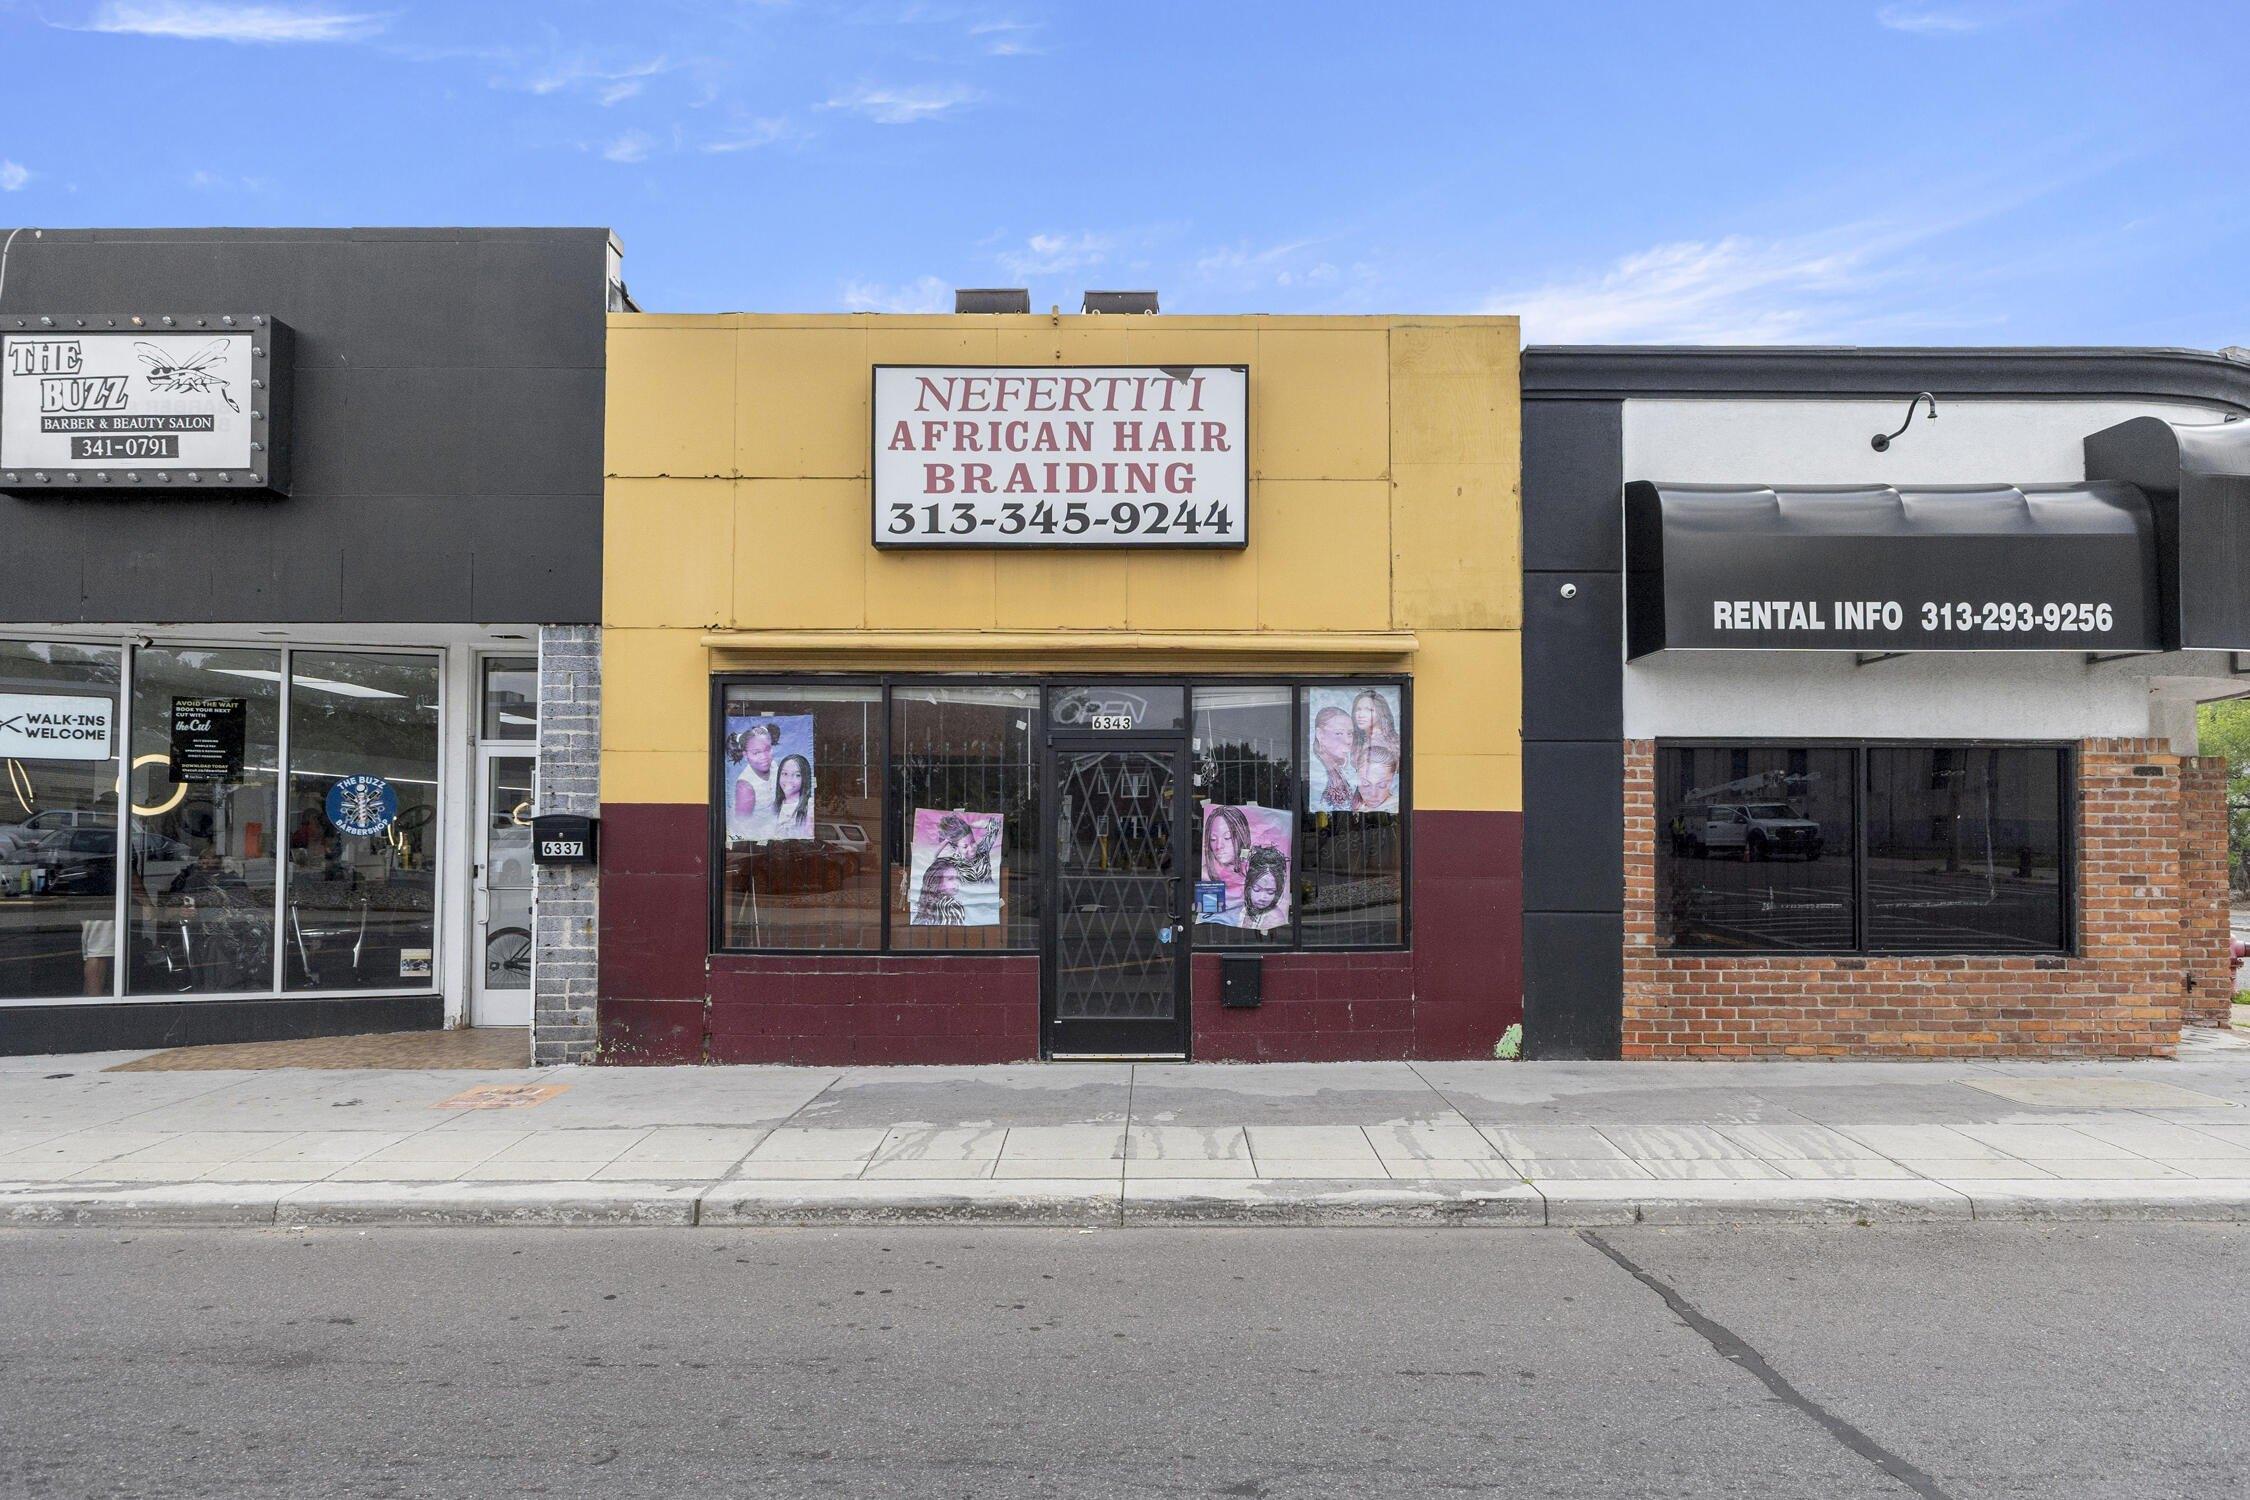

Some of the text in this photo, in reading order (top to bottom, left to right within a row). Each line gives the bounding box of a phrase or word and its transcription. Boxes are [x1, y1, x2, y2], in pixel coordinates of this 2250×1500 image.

[9, 340, 83, 376] THE
[41, 376, 129, 412] BUZZ
[914, 376, 1206, 412] NEFERTITI
[44, 416, 212, 430] BARBER & BEAUTY SALON
[888, 420, 1231, 452] AFRICAN HAIR
[82, 438, 168, 456] 341-0791
[923, 462, 1196, 494] BRAIDING
[887, 499, 1234, 535] 313-345-9244
[1713, 601, 2114, 632] RENTAL INFO 313-293-9256
[26, 713, 105, 726] WALK-INS
[1060, 700, 1147, 724] OPEN
[25, 727, 105, 740] WELCOME
[1093, 717, 1131, 729] 6343
[337, 776, 386, 790] THE BUZZ
[336, 819, 388, 836] BARBERSHOP
[544, 842, 581, 855] 6337
